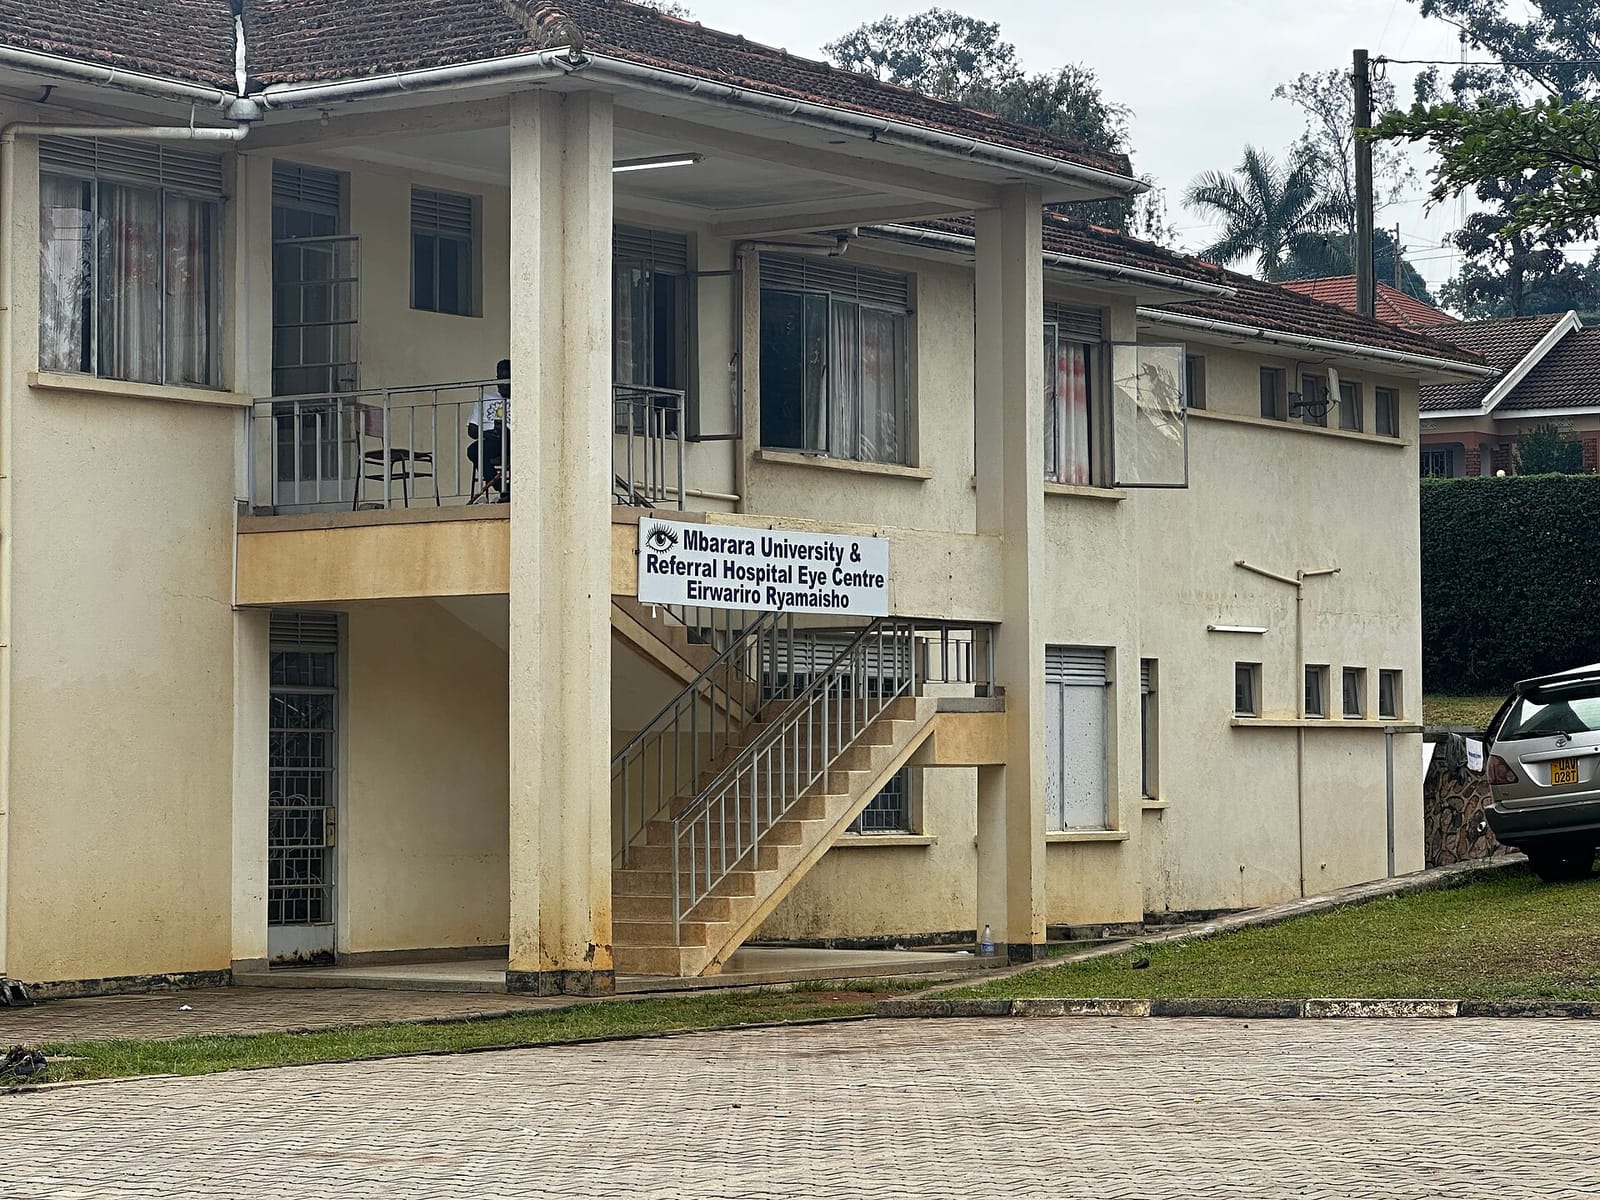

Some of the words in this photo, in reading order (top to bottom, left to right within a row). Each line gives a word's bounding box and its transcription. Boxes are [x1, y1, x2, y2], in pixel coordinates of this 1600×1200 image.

[683, 529, 755, 556] Mbarara
[761, 536, 844, 567] University
[849, 542, 861, 562] &
[646, 553, 717, 578] Referral
[723, 560, 793, 585] Hospital
[798, 566, 827, 589] Eye
[832, 567, 885, 588] Centre
[687, 580, 761, 604] Eirwariro
[766, 586, 850, 610] Ryamaisho
